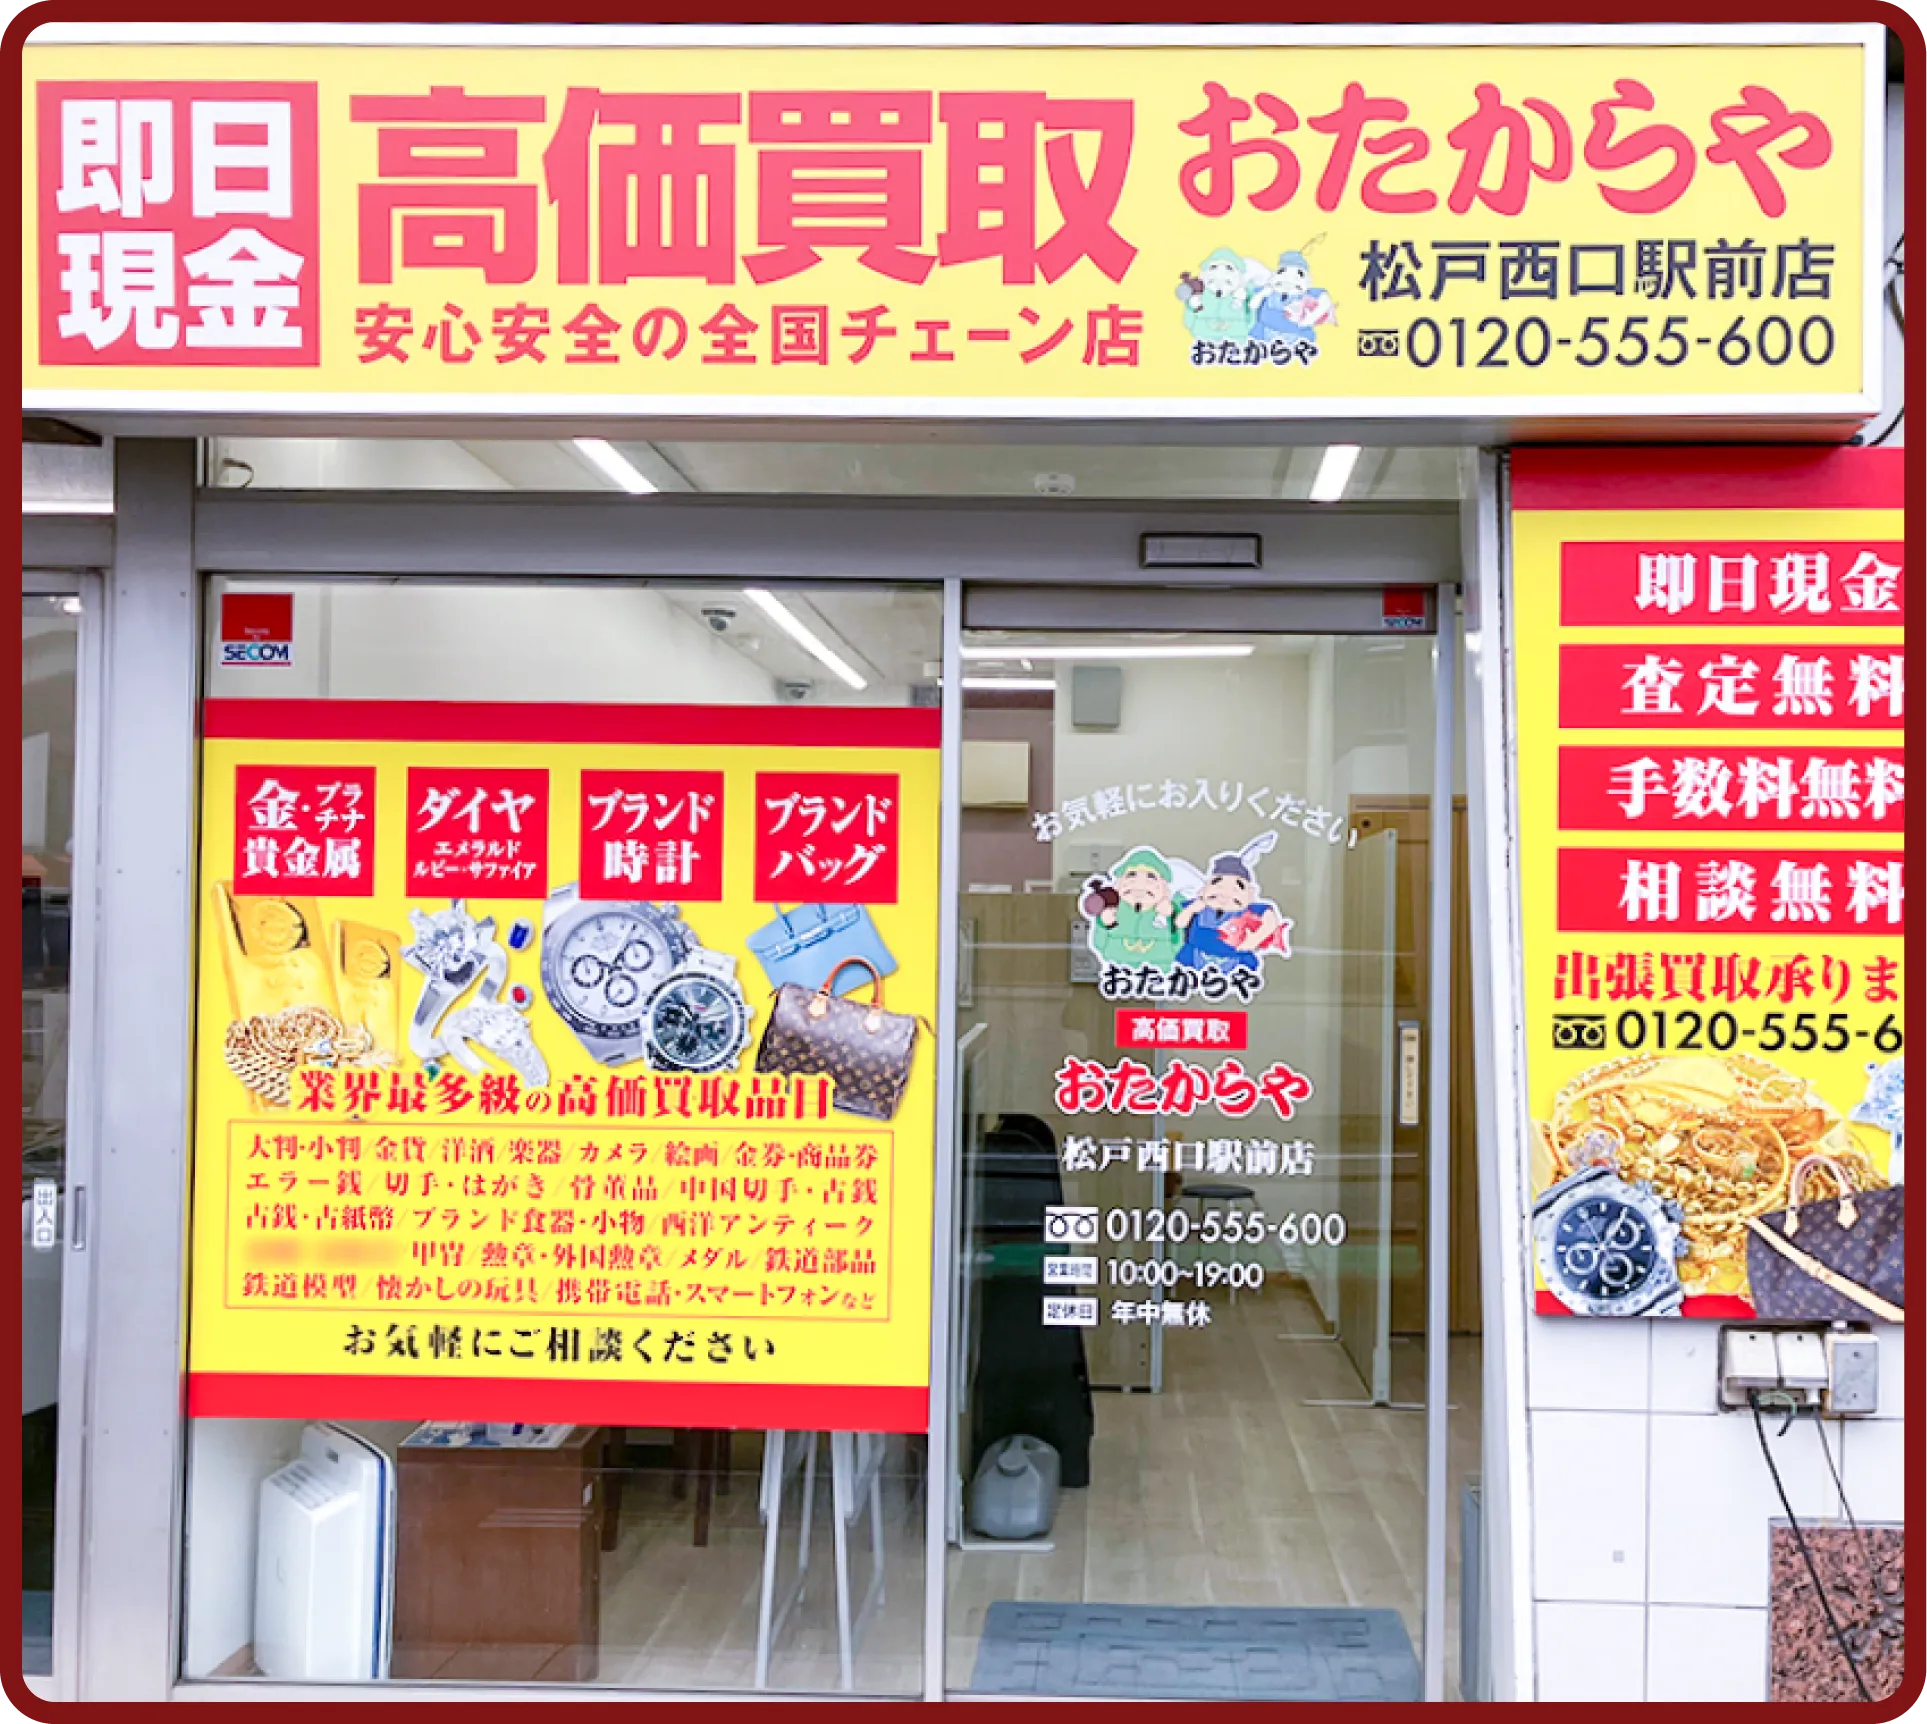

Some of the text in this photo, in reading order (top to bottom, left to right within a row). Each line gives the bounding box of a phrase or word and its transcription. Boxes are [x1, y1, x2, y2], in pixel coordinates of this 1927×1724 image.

[56, 99, 294, 219] 即日
[1178, 79, 1834, 218] おたからや
[350, 85, 1139, 285] 高価買取
[56, 228, 304, 351] 現金
[1359, 238, 1836, 301] 松戸西口駅前店
[354, 302, 1144, 367] 安心安全の全国チェーン店
[1191, 337, 1319, 366] おたからや
[1407, 315, 1836, 368] 0120-555-600
[1634, 551, 1902, 614] 即日現金
[224, 643, 289, 661] SECOM
[1620, 654, 1904, 717] 査定無料
[416, 786, 536, 833] ダイヤ
[587, 788, 716, 834] ブランド
[765, 791, 893, 838] ブランド
[1031, 778, 1358, 850] お気軽にお入りください
[242, 836, 362, 879] 貴金属
[434, 839, 522, 859] エメラルド
[604, 838, 701, 885] 時計
[769, 843, 888, 886] バッグ
[1618, 858, 1904, 923] 相談無料
[1103, 964, 1261, 1000] おたからや
[1131, 1016, 1231, 1044] 高価買取
[297, 1069, 829, 1120] 業界最多級の高価買取品目
[1055, 1055, 1314, 1121] おたからや
[1062, 1135, 1315, 1175] 松戸西口駅前店
[36, 1189, 53, 1242] 出入口
[1105, 1207, 1347, 1246] 0120-555-600
[1111, 1300, 1212, 1326] 年中無休
[343, 1322, 776, 1364] お気軽にご相談ください
